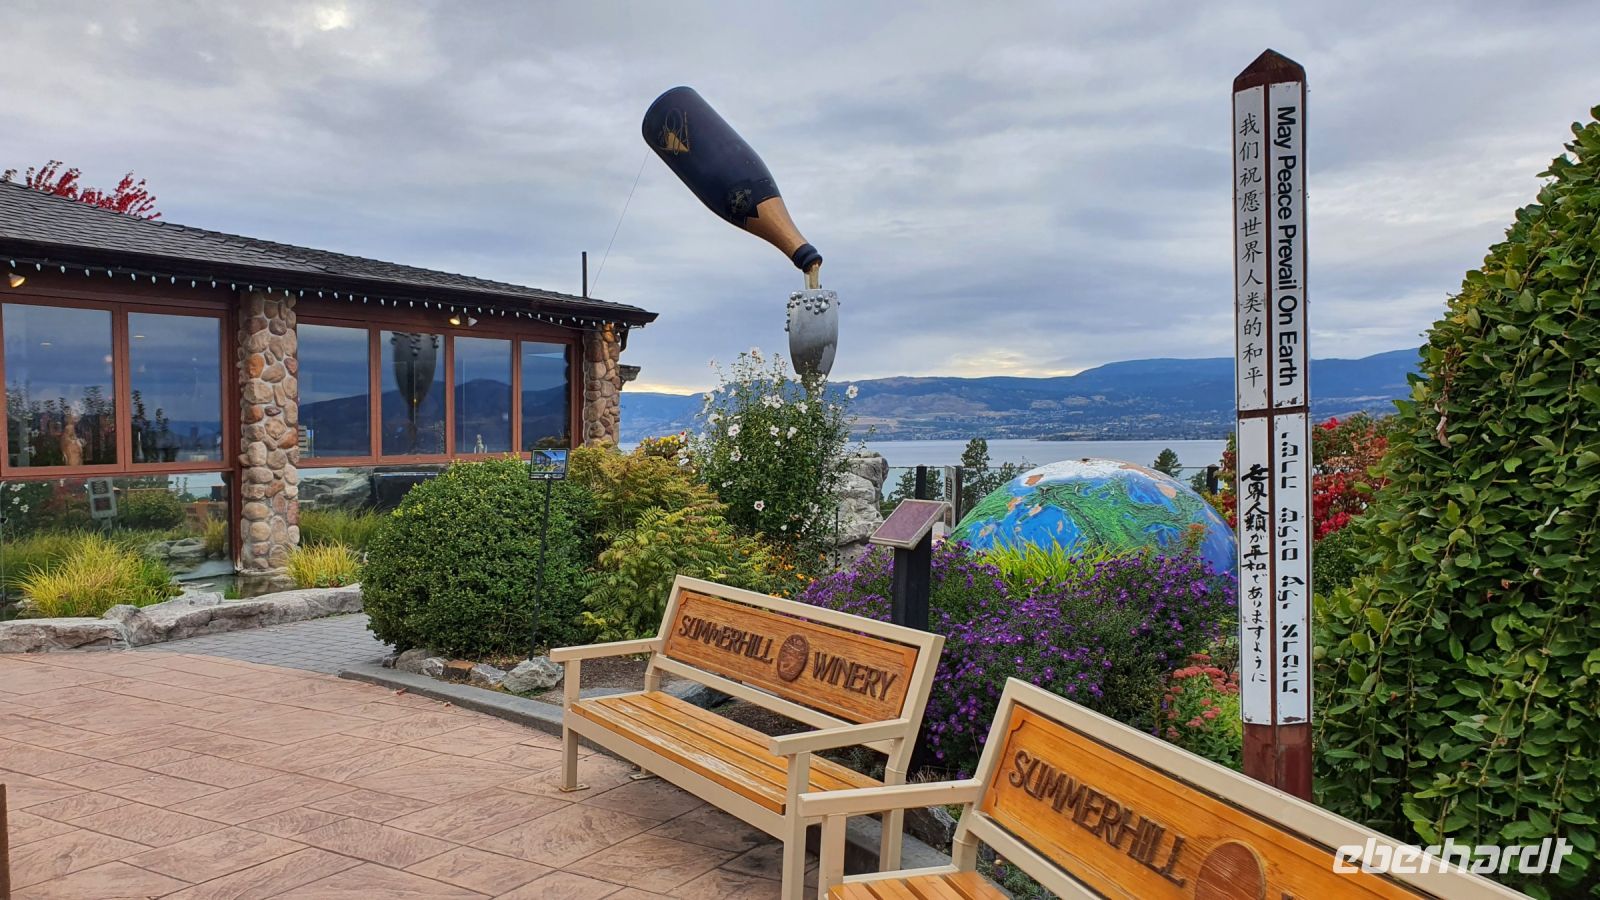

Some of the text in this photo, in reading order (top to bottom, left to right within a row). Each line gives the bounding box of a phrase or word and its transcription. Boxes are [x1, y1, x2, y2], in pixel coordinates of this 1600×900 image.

[1239, 112, 1264, 388] 我们祝愿世界人类的和平
[1273, 106, 1298, 387] May Peace Prevail On Earth
[1241, 463, 1268, 683] 世界人類が平和でありますように
[1277, 507, 1299, 561] שלום
[1277, 575, 1305, 610] עלי
[678, 615, 898, 701] SUMMERHILL WINERY
[1281, 623, 1299, 694] אדמות
[1008, 749, 1188, 888] SUMMERHILL
